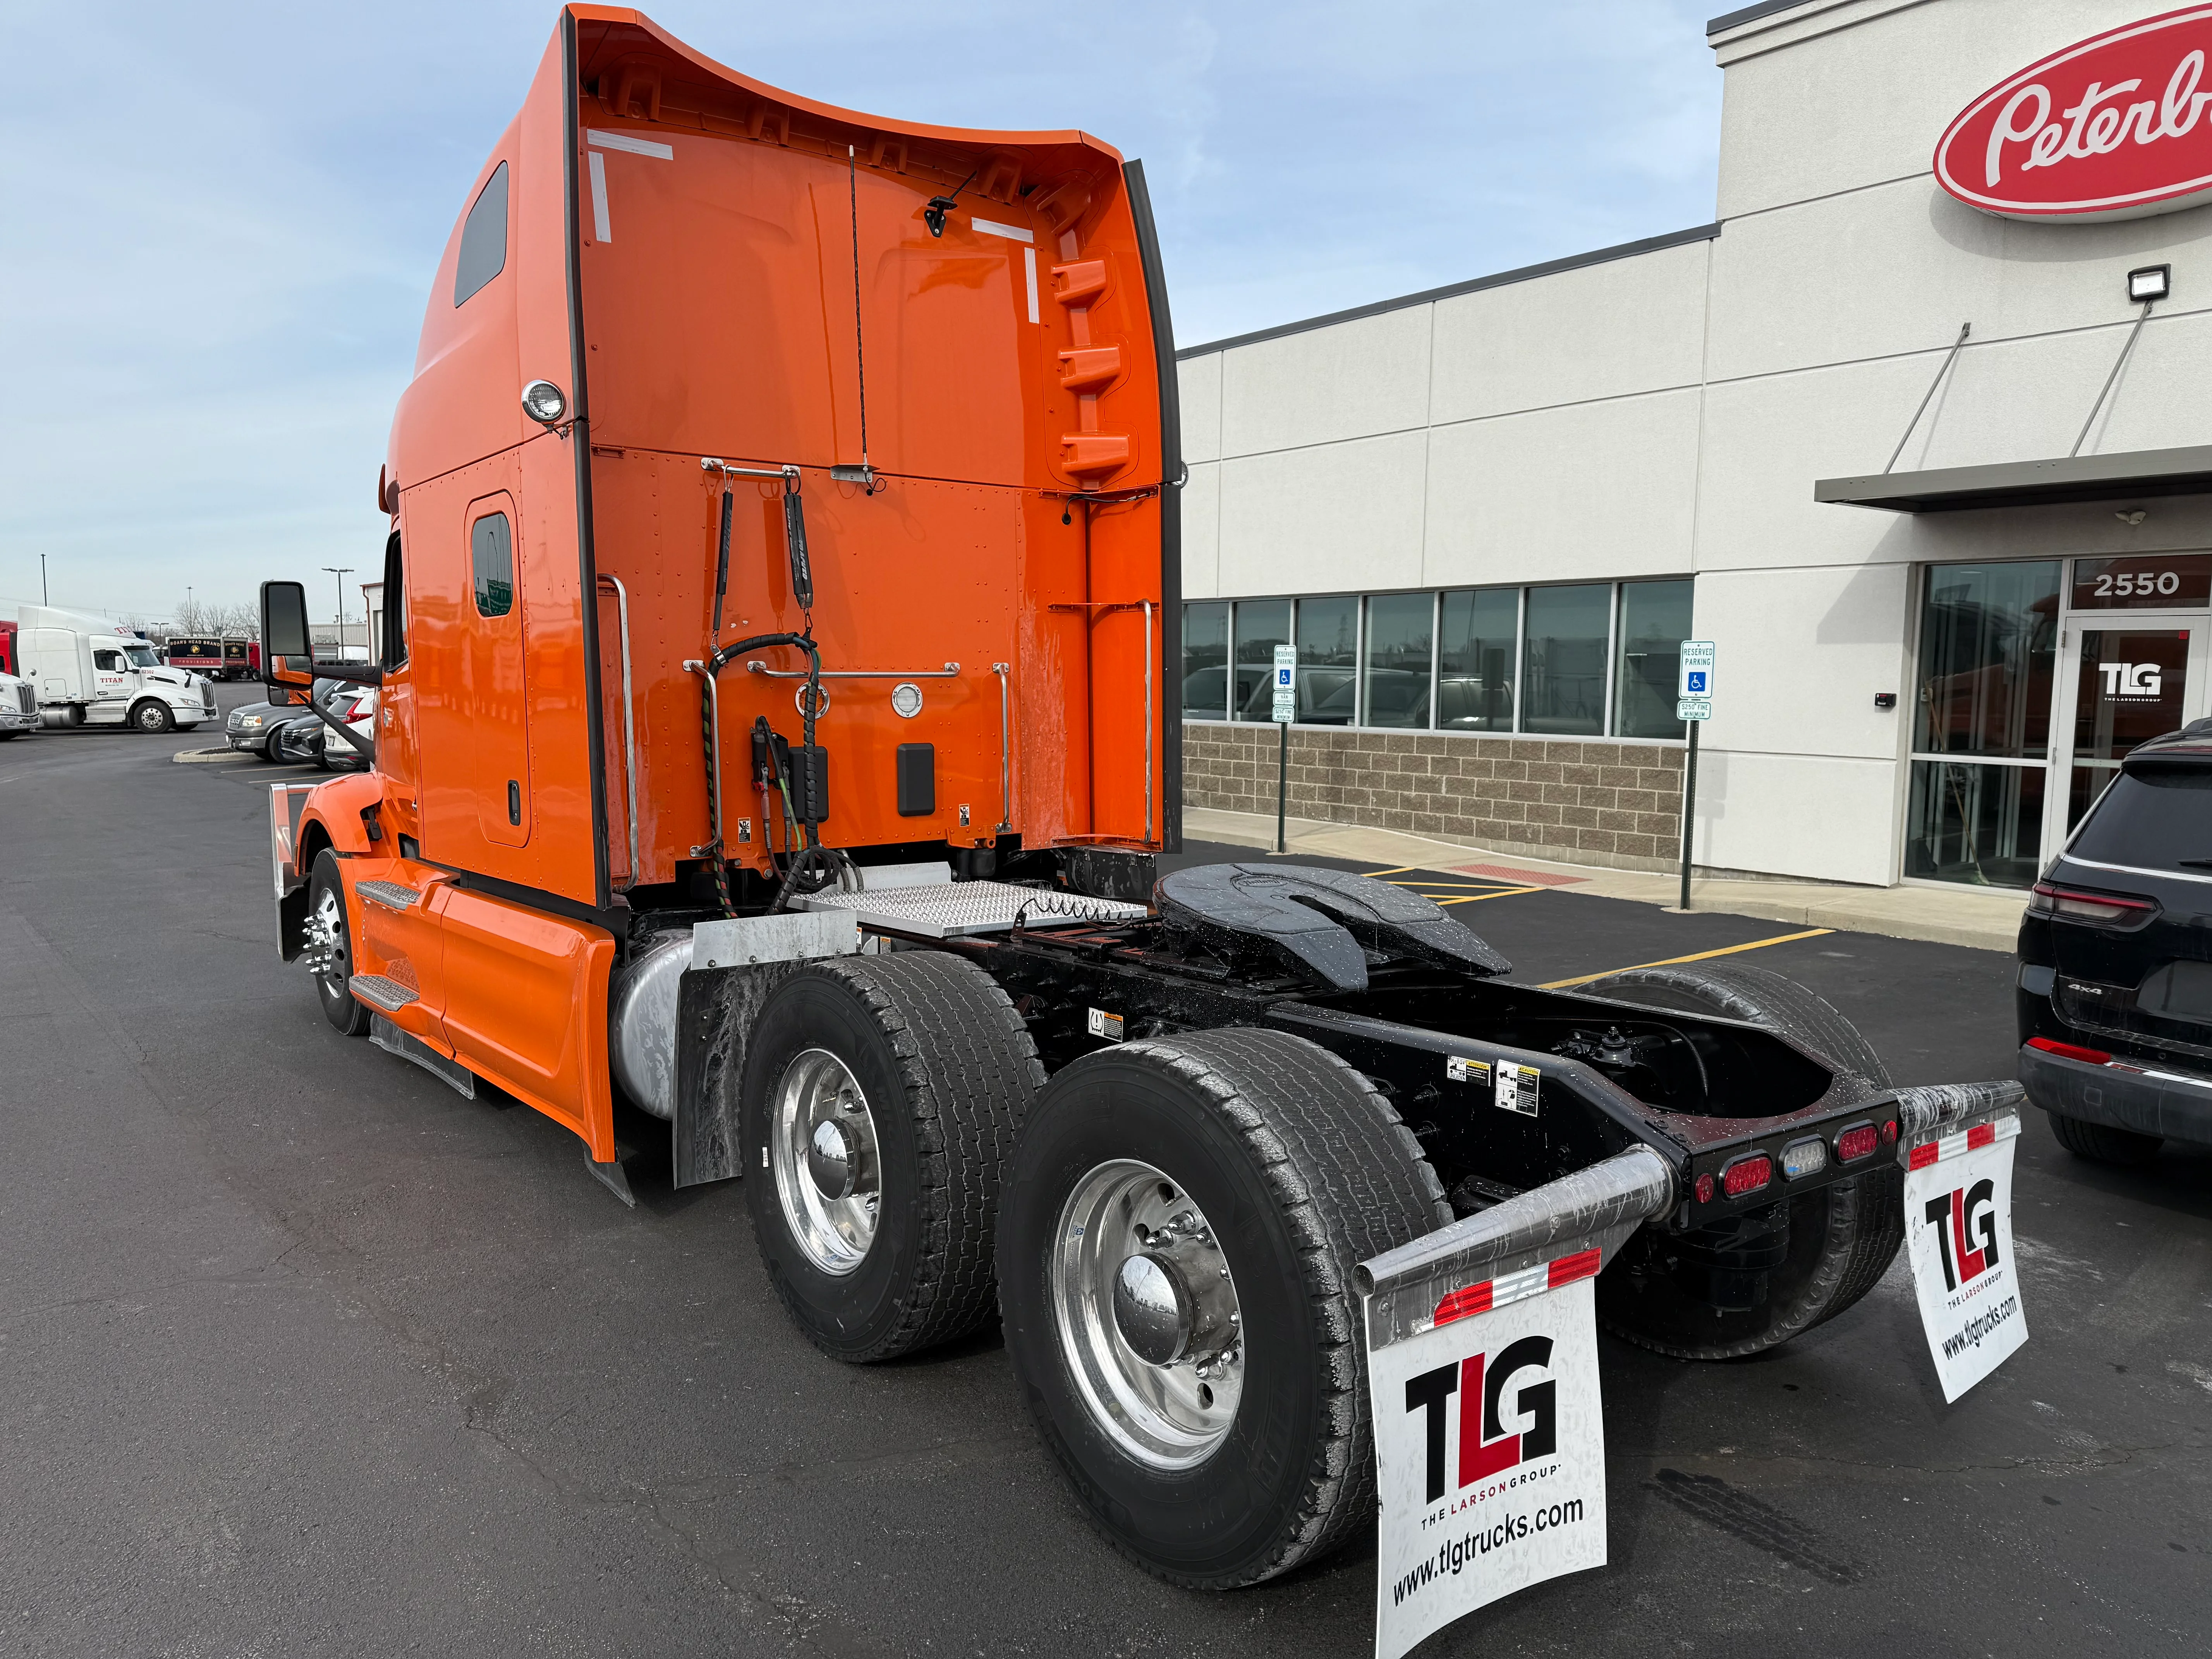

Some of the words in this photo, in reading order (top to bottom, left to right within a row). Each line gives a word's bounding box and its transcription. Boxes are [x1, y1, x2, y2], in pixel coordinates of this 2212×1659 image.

[2094, 572, 2179, 596] 2550
[2099, 663, 2161, 695] TLG
[2068, 984, 2102, 995] 4x4
[1925, 1178, 1999, 1293] TLG
[1948, 1297, 1960, 1310] THE
[1961, 1282, 1984, 1302] LARSON
[1985, 1271, 2001, 1288] GROUP
[1942, 1295, 2017, 1360] www.tlgtrucks.com
[1406, 1336, 1556, 1505] TLG
[1421, 1508, 1445, 1530] THE
[1451, 1482, 1506, 1515] LARSON
[1510, 1465, 1556, 1488] GROUP
[1393, 1497, 1583, 1607] www.tlgtrucks.com
